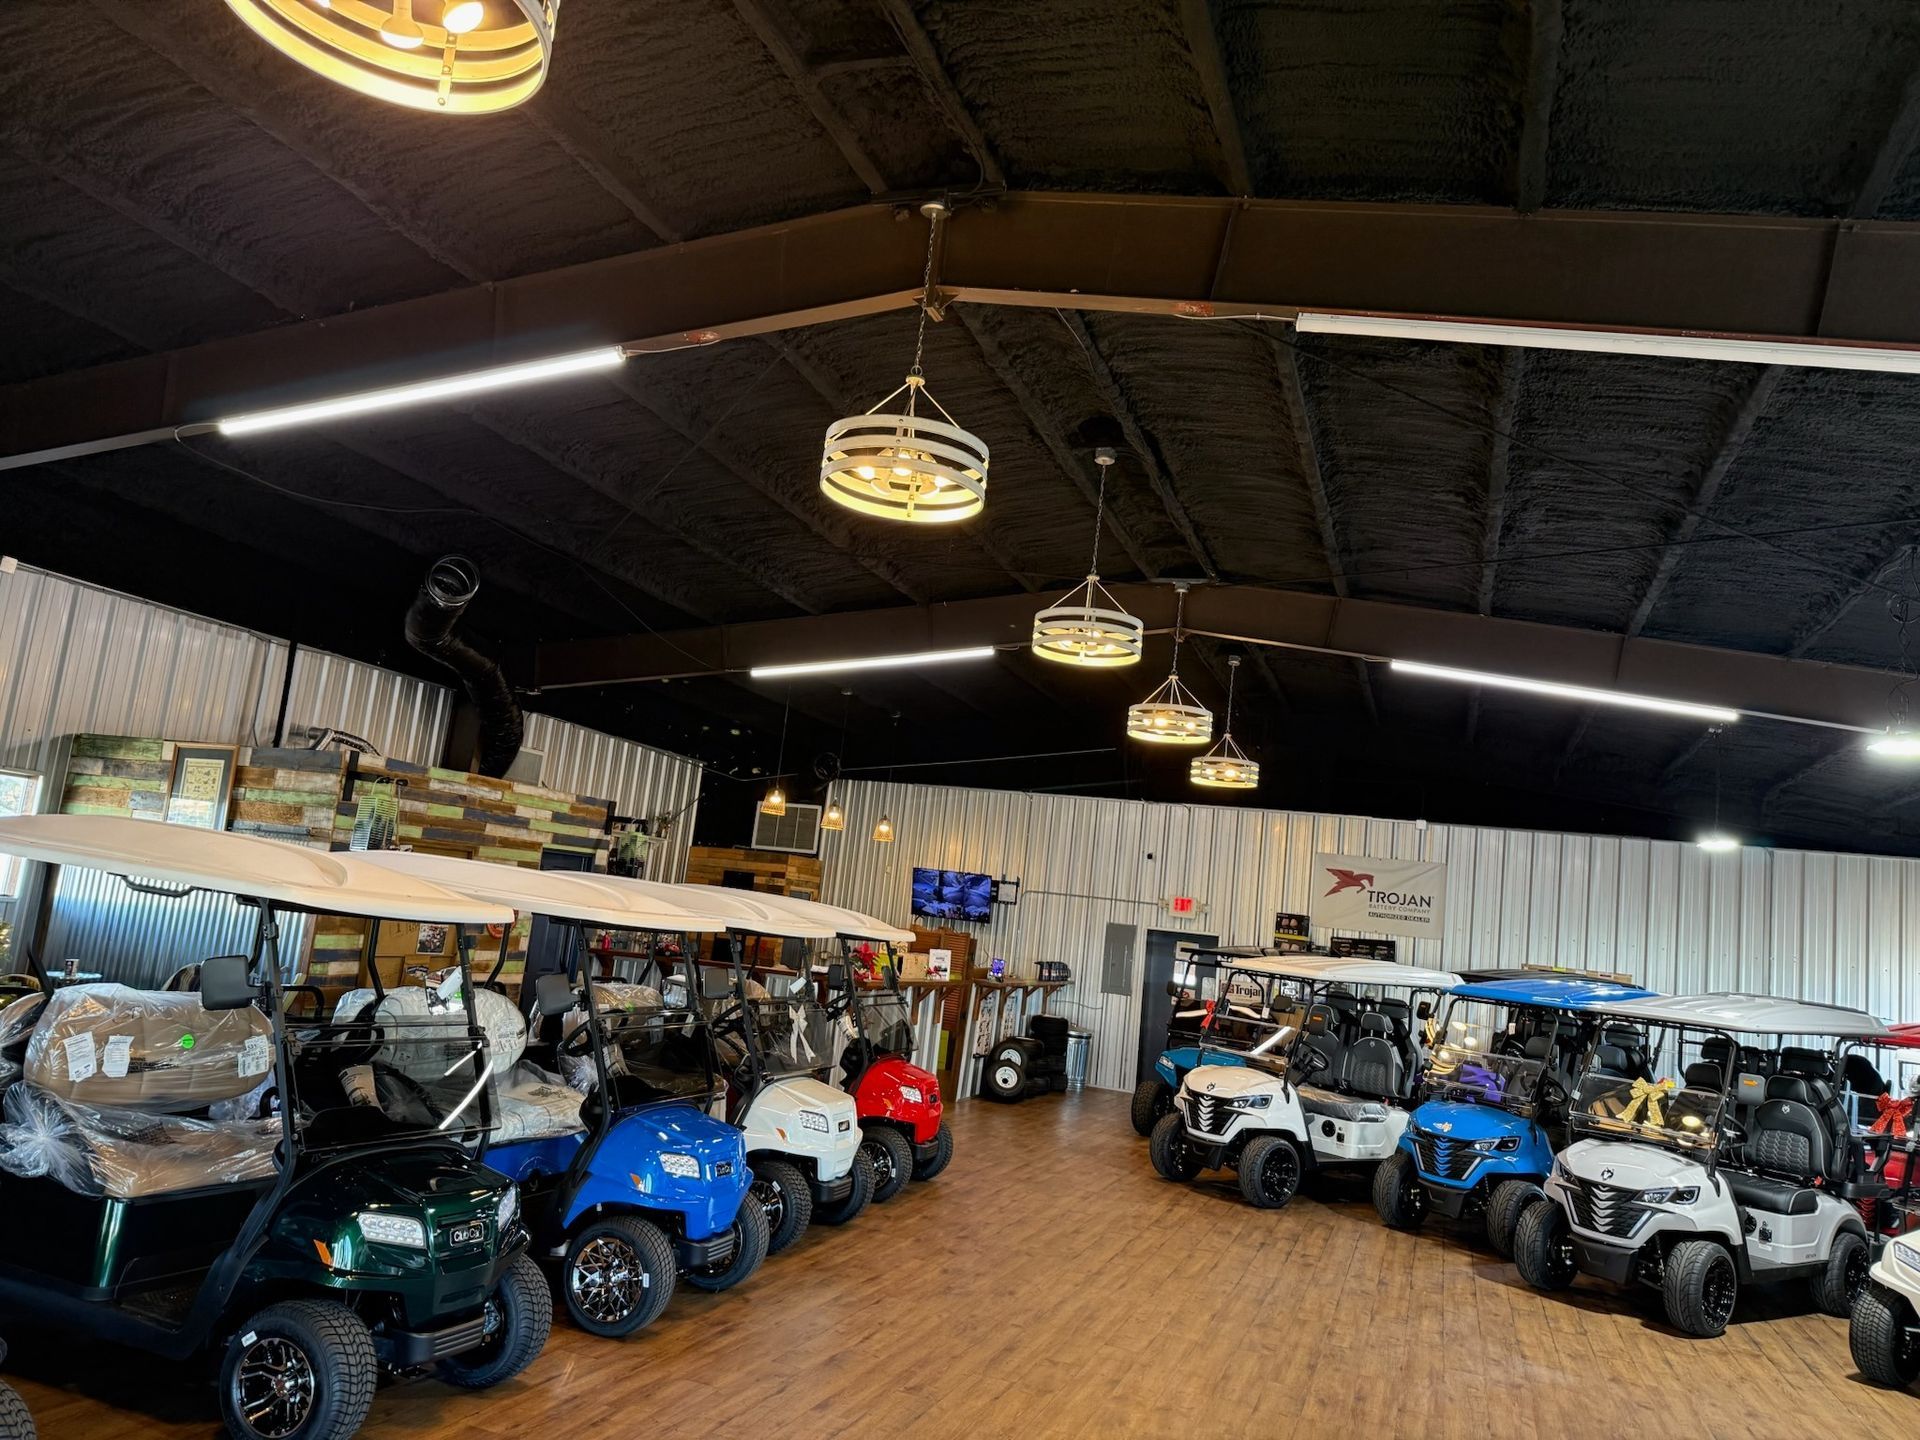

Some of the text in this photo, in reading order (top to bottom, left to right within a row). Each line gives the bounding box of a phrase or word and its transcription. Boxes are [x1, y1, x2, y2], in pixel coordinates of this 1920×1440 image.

[1367, 890, 1431, 908] TROJAN
[1368, 903, 1431, 914] BATTERY COMPANY
[1368, 912, 1430, 923] AUTHORIZED DEALER
